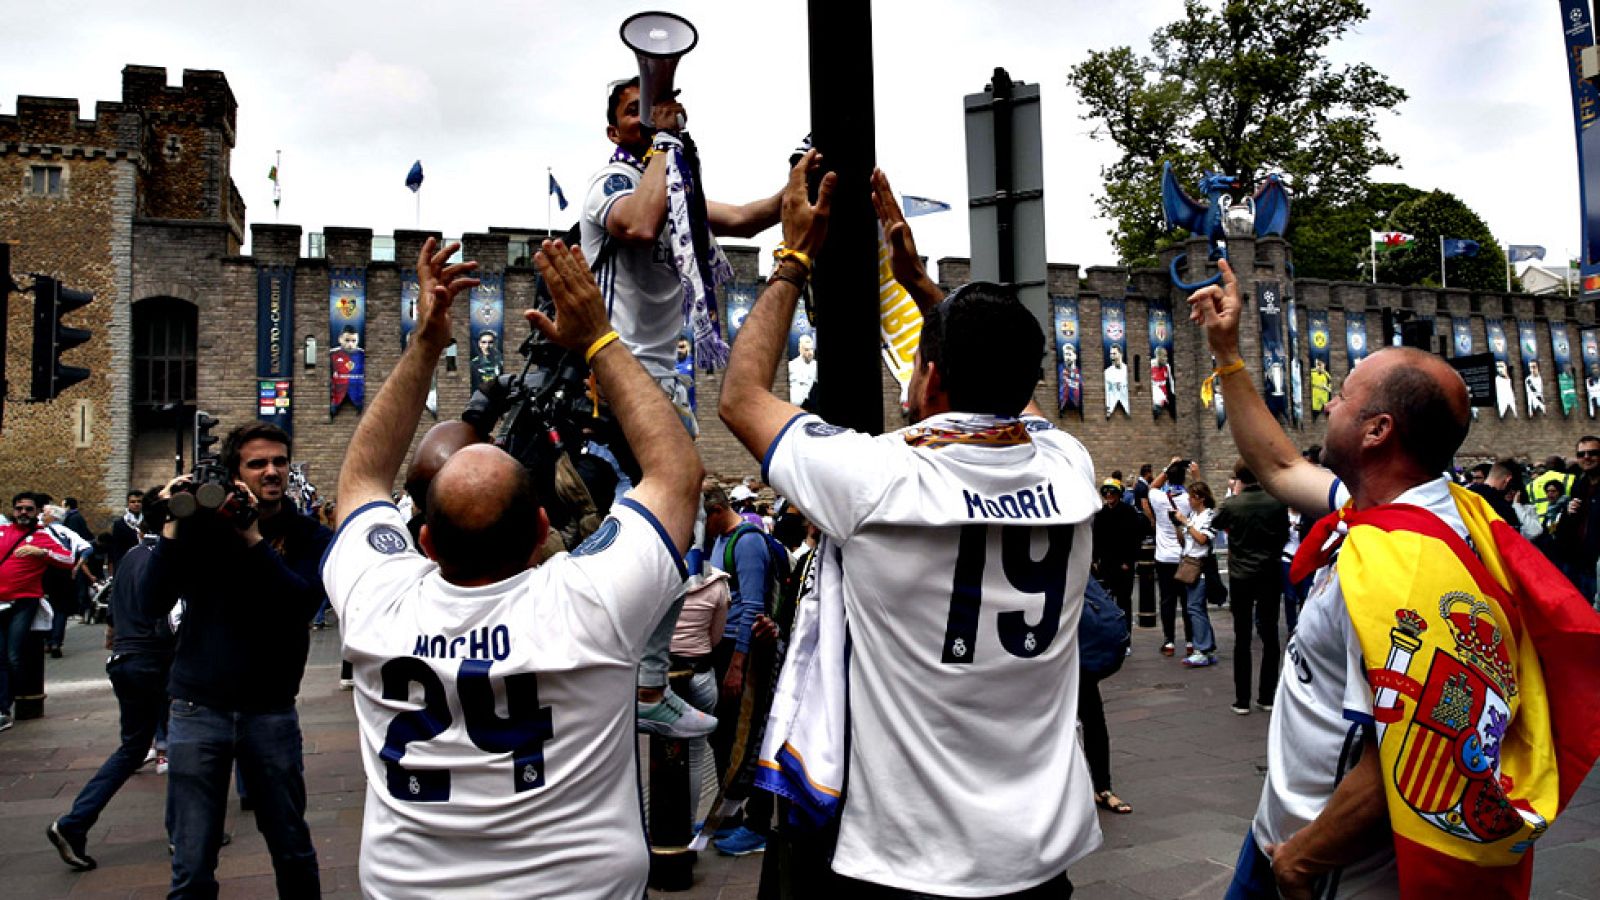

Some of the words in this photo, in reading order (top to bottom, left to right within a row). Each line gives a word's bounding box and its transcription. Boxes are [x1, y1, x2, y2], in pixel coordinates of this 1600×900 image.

[270, 277, 280, 322] CARDIFF
[270, 327, 280, 343] TO
[270, 344, 280, 374] ROAD
[941, 524, 1075, 663] 19
[379, 656, 554, 803] 24
